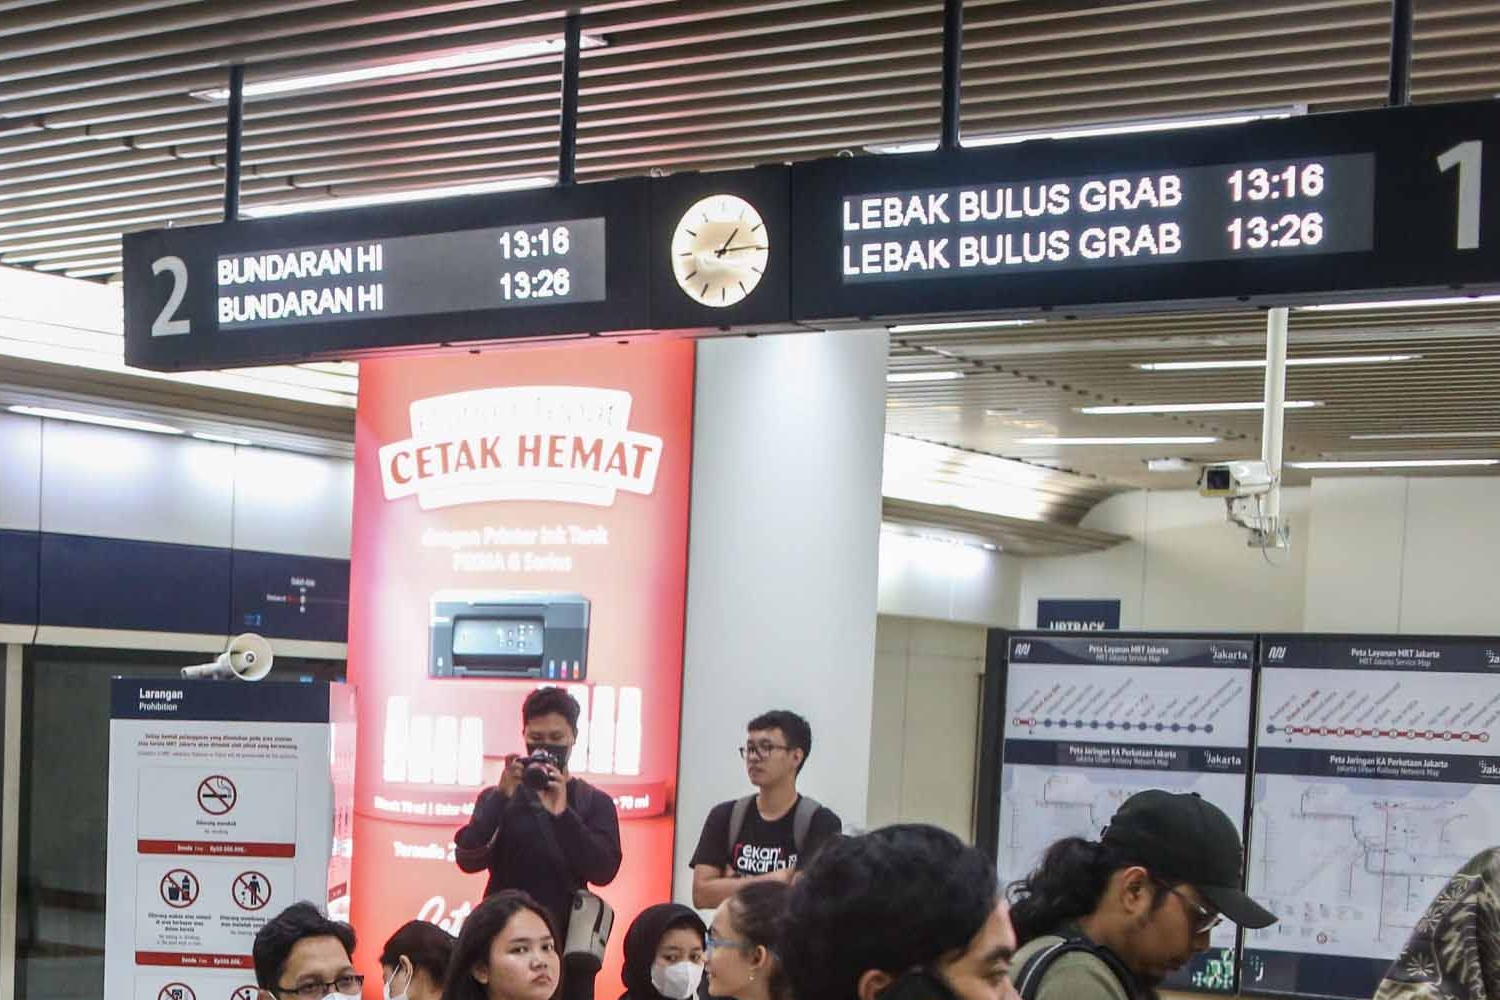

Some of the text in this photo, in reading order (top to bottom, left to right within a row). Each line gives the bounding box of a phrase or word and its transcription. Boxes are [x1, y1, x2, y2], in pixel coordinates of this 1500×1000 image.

[843, 163, 1325, 231] LEBAK BULUS GRAB 13:16
[1436, 140, 1483, 249] 1
[218, 228, 570, 286] BUNDARAN HI 13:16
[843, 212, 1324, 276] LEBAK BULUS GRAB 13:26
[150, 256, 190, 336] 2
[218, 268, 570, 323] BUNDARAN HI 13:26
[391, 435, 653, 484] CETAK HEMAT
[1213, 650, 1248, 660] Jakarta
[139, 688, 184, 701] Larangan
[139, 702, 178, 712] Prohibition
[1206, 754, 1242, 765] Jakarta
